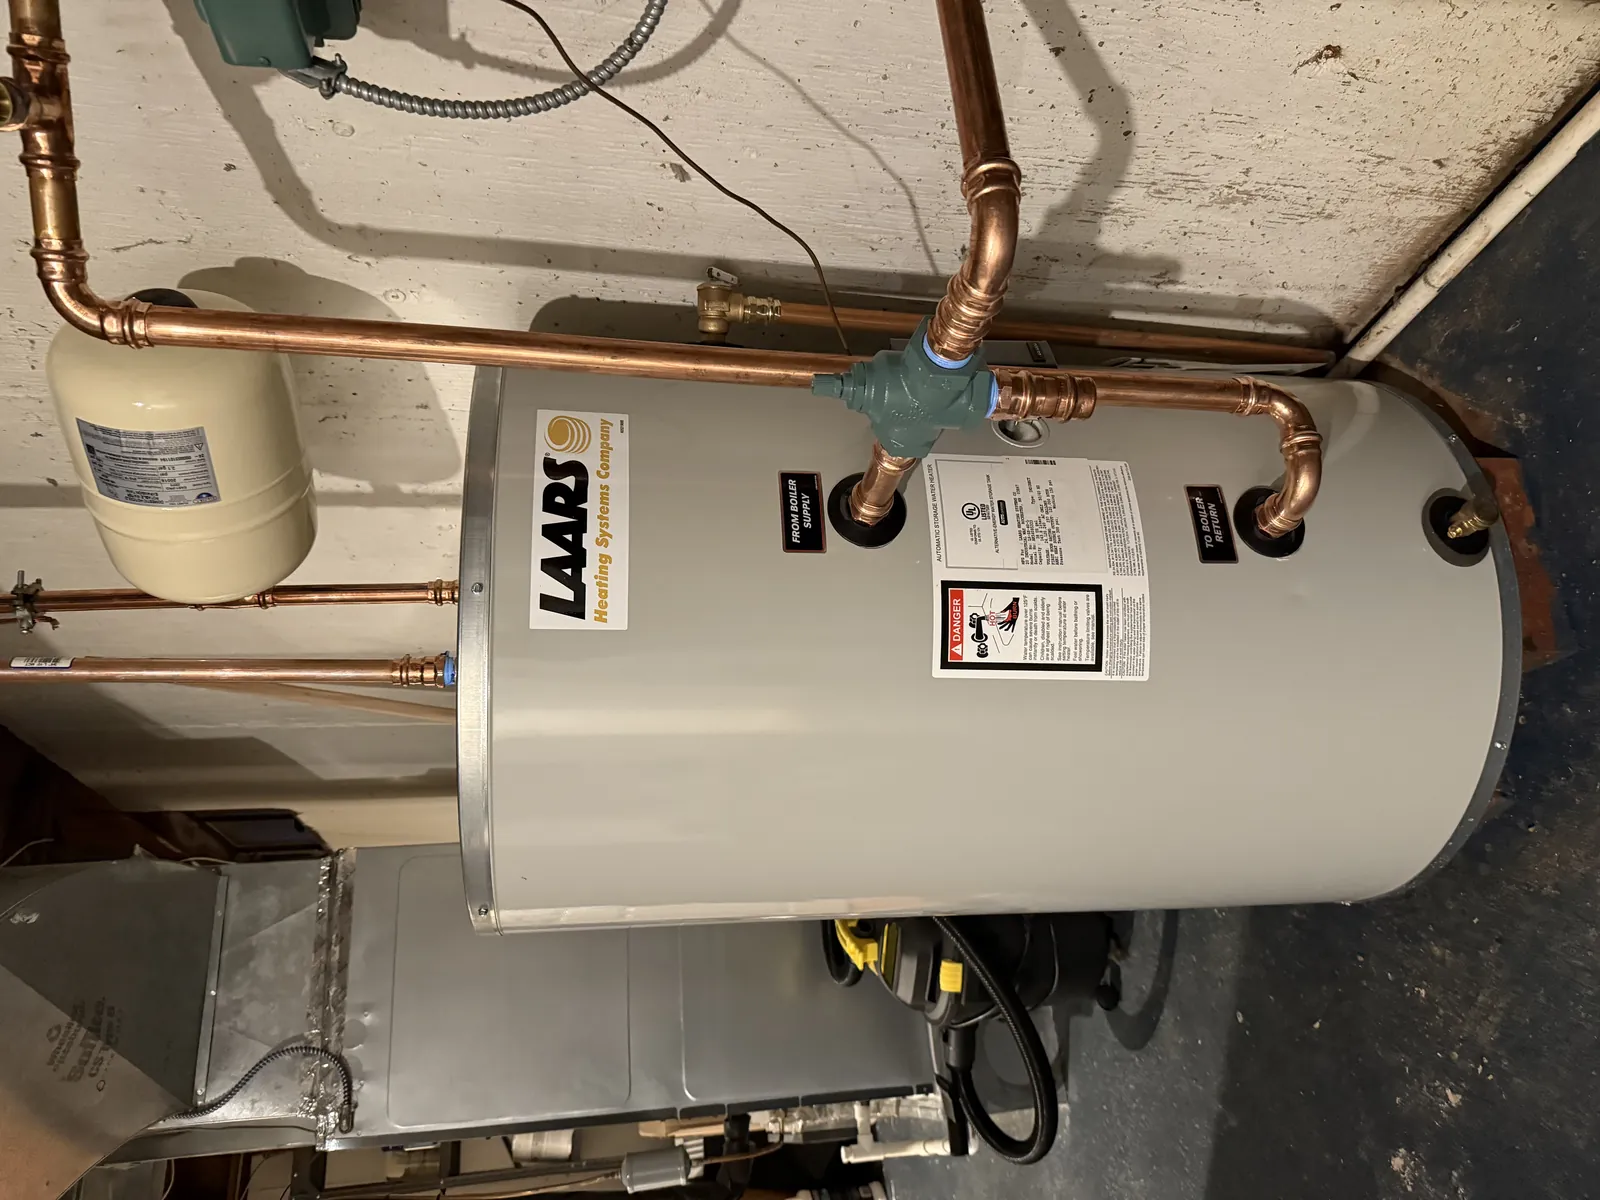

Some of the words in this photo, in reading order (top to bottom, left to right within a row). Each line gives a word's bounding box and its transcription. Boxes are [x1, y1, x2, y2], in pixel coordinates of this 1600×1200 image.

[597, 419, 613, 479] Company
[788, 479, 798, 512] BOILER
[801, 493, 811, 528] SUPPLY
[596, 484, 612, 548] Systems
[791, 514, 800, 543] FROM
[1195, 497, 1210, 532] BOILER
[1207, 503, 1224, 542] RETURN
[540, 457, 588, 620] LAARS
[1204, 535, 1214, 548] TO
[594, 553, 612, 623] Heating
